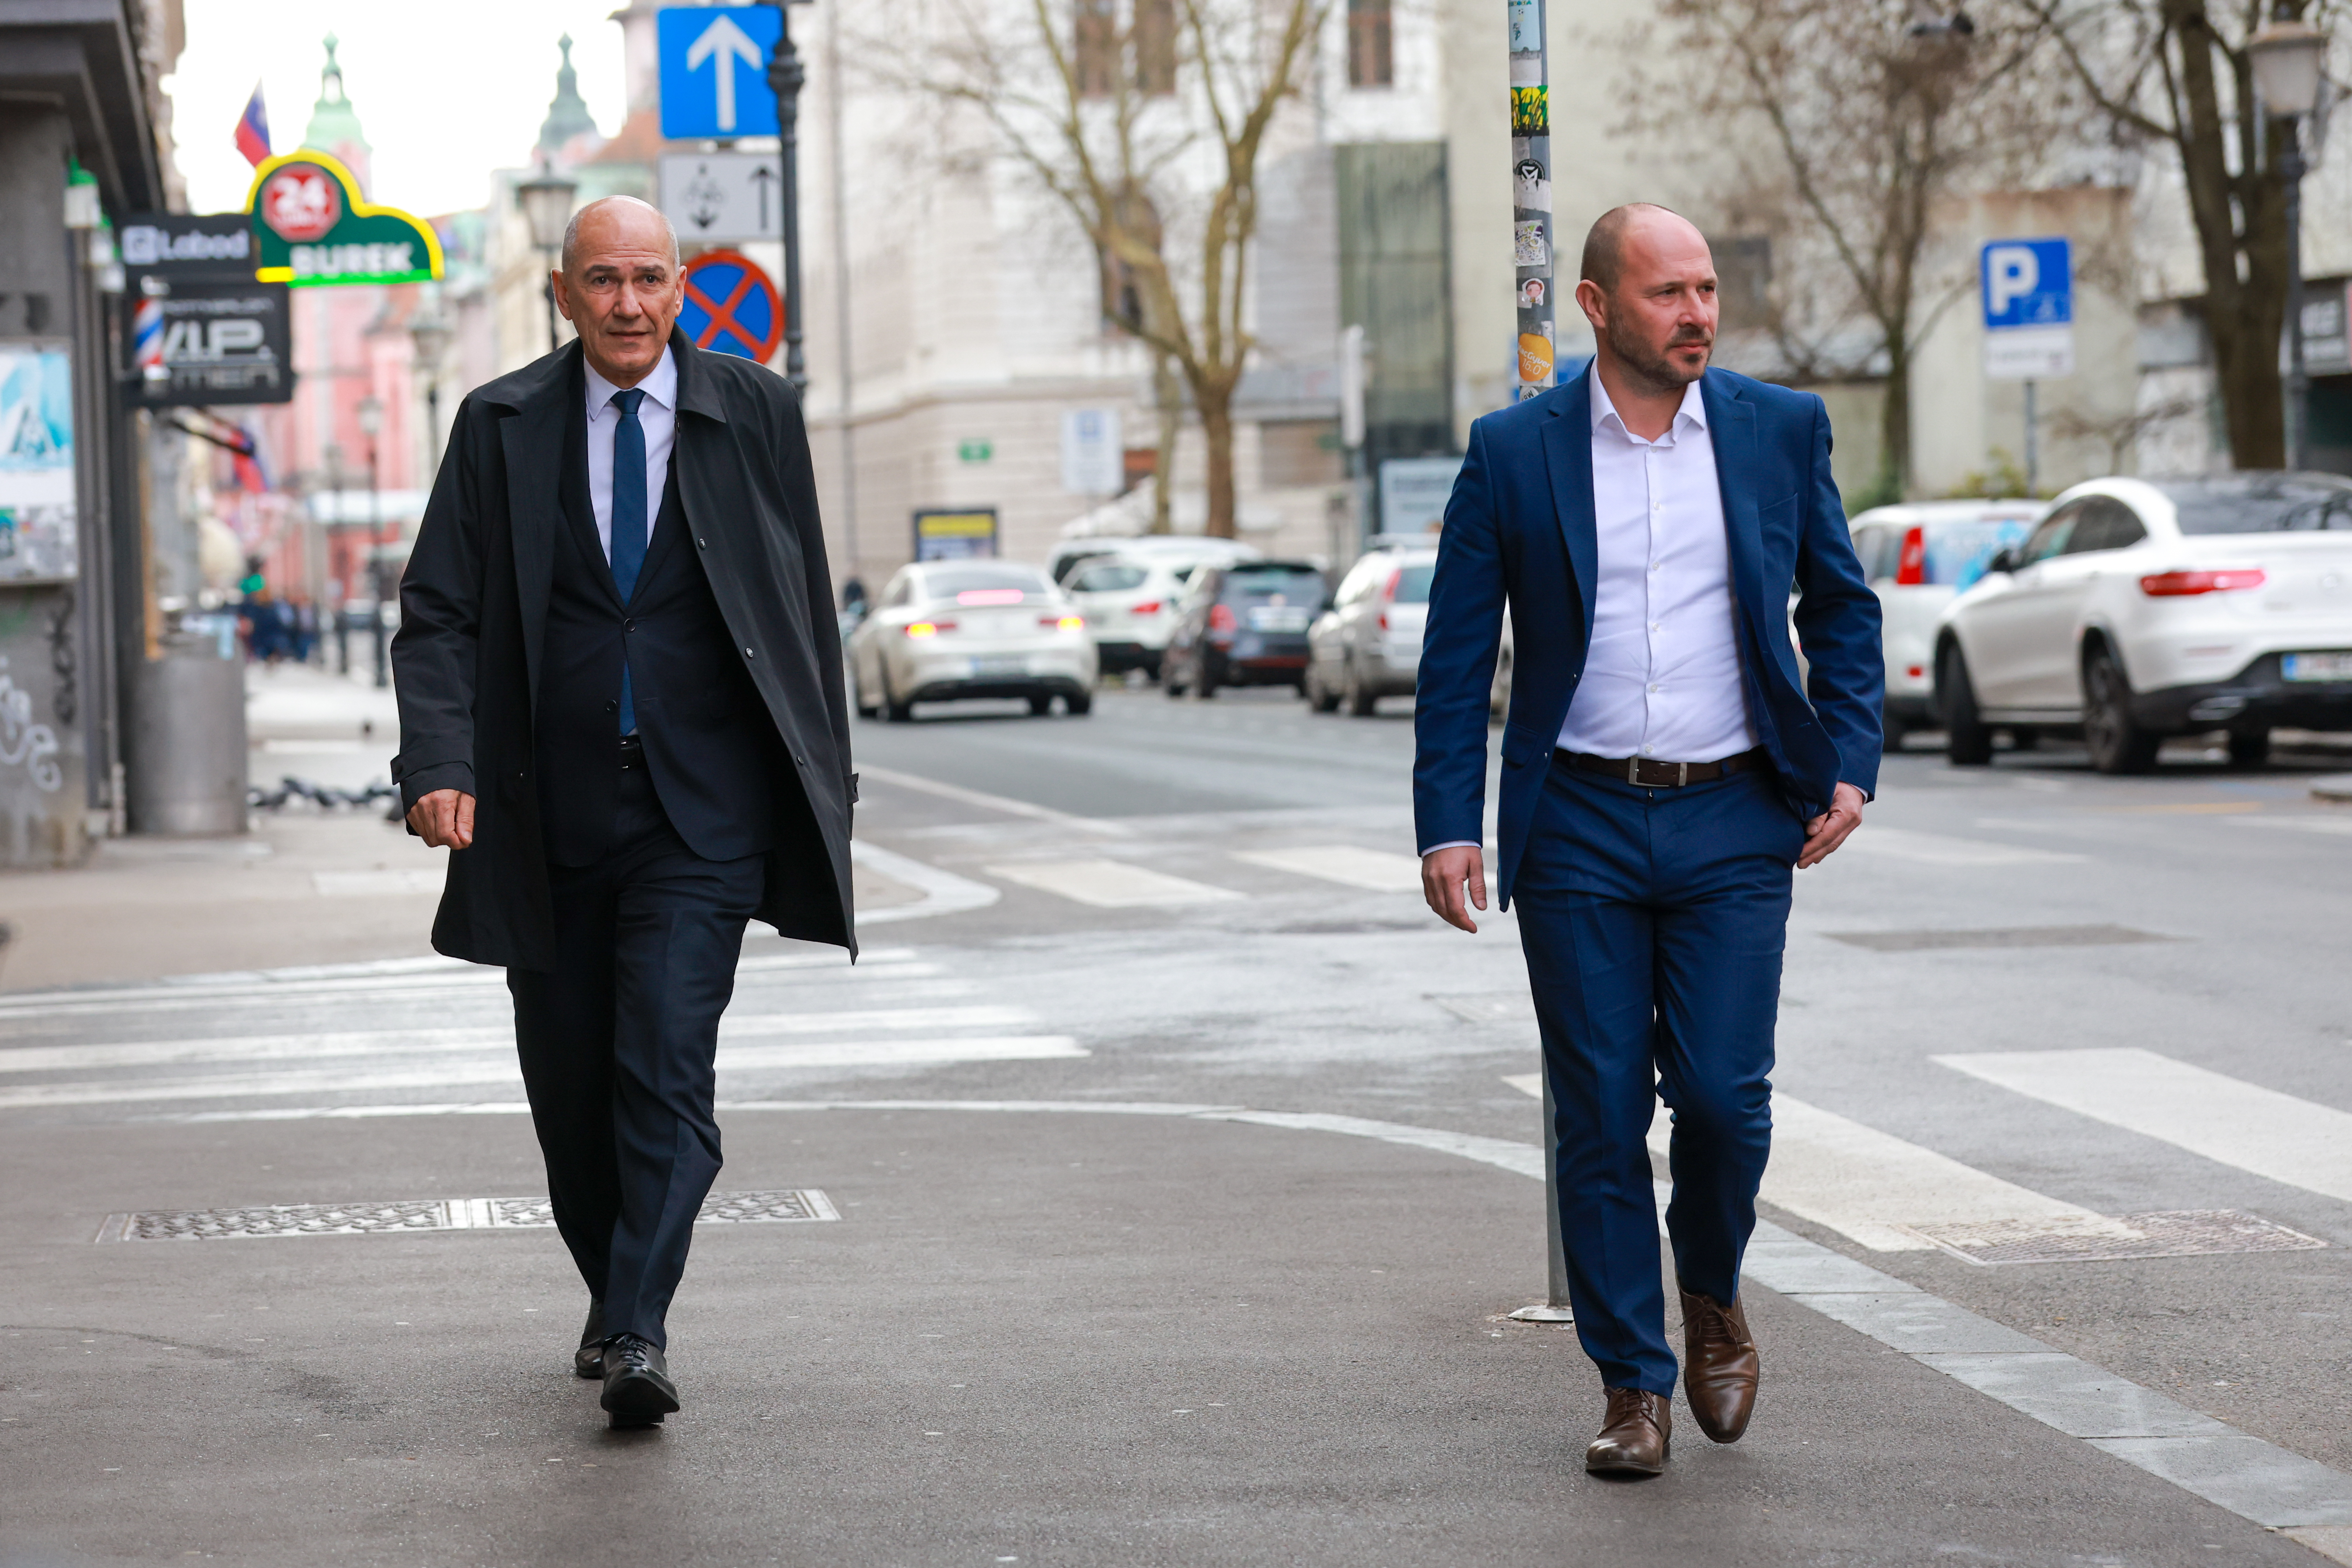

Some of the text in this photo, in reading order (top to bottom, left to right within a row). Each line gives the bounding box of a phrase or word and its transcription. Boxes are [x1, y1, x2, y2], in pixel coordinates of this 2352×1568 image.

[273, 176, 328, 214] 24
[290, 242, 414, 277] BUREK
[1988, 247, 2040, 316] P
[1523, 358, 1541, 375] 16.0
